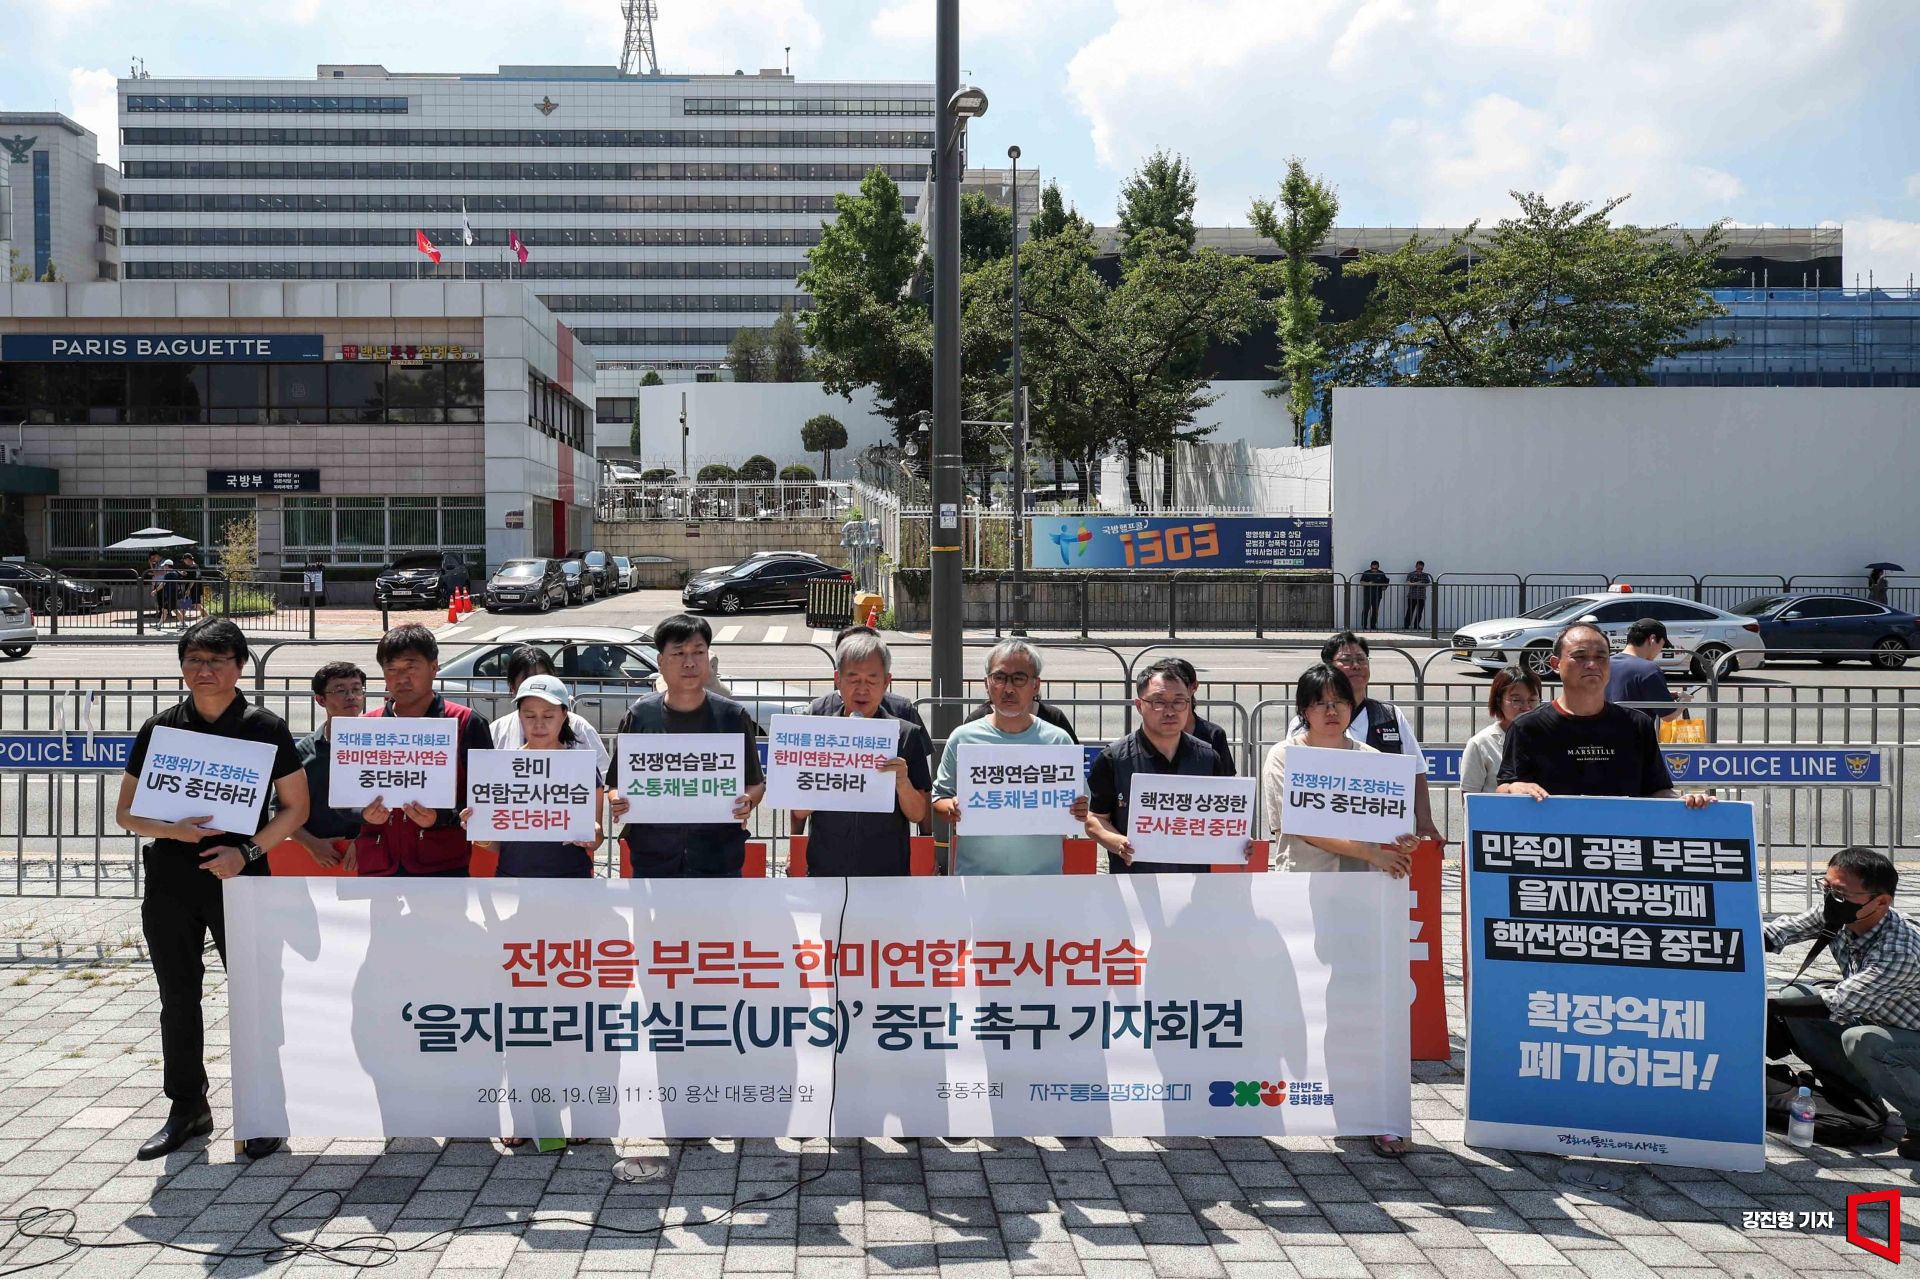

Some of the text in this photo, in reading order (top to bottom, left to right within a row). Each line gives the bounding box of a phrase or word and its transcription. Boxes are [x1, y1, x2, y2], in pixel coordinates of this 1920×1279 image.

[52, 339, 272, 356] PARIS BAGUETTE
[226, 475, 263, 488] 국방부
[1119, 522, 1220, 567] 1303
[1288, 531, 1301, 539] 상담
[337, 732, 450, 747] 적대를 멈추고 대화로!
[775, 732, 892, 750] 적대를 멈추고 대화로!
[82, 743, 126, 762] LINE
[336, 750, 449, 766] 한미연합군사연습
[628, 752, 737, 773] 전쟁연습말고
[773, 750, 888, 771] 한미연합군사연습
[152, 753, 260, 784] 전쟁위기 조장하는
[511, 757, 551, 779] 한미
[969, 764, 1076, 785] 전쟁연습말고
[1698, 756, 1837, 776] POLICE LINE
[146, 772, 257, 808] UFS 중단하라
[358, 770, 428, 789] 중단하라
[627, 777, 737, 798] 소통채널 마련
[796, 772, 867, 793] 중단하라
[1290, 772, 1406, 796] 전쟁위기 조장하는
[471, 783, 590, 805] 연합군사연습
[967, 788, 1076, 810] 소통채널 마련
[1139, 791, 1247, 813] 핵전쟁 상정한
[1289, 791, 1407, 819] UFS 중단하라
[491, 809, 571, 831] 중단하라
[1135, 815, 1247, 837] 군사훈련 중단!
[1481, 834, 1745, 875] 민족의 공멸 부르는
[1517, 879, 1707, 918] 을지자유방패
[1492, 920, 1740, 965] 핵전쟁연습 중단!
[502, 937, 1149, 990] 전쟁을 부르는 한미연합군사연습
[872, 1001, 963, 1051] 중단
[970, 1002, 1060, 1050] 촉구
[1068, 999, 1244, 1050] 기자회견
[1527, 990, 1706, 1041] 확장억제
[1518, 1041, 1720, 1091] 폐기하라!
[477, 1087, 522, 1104] 2024.
[531, 1087, 556, 1104] 08.
[685, 1085, 720, 1104] 용산
[724, 1085, 793, 1104] 대통령실
[797, 1085, 815, 1104] 앞
[935, 1081, 1004, 1100] 공동주최
[1028, 1083, 1192, 1102] 자주통일평화연대
[1289, 1082, 1323, 1093] 한반도
[1289, 1094, 1335, 1106] 평화행동
